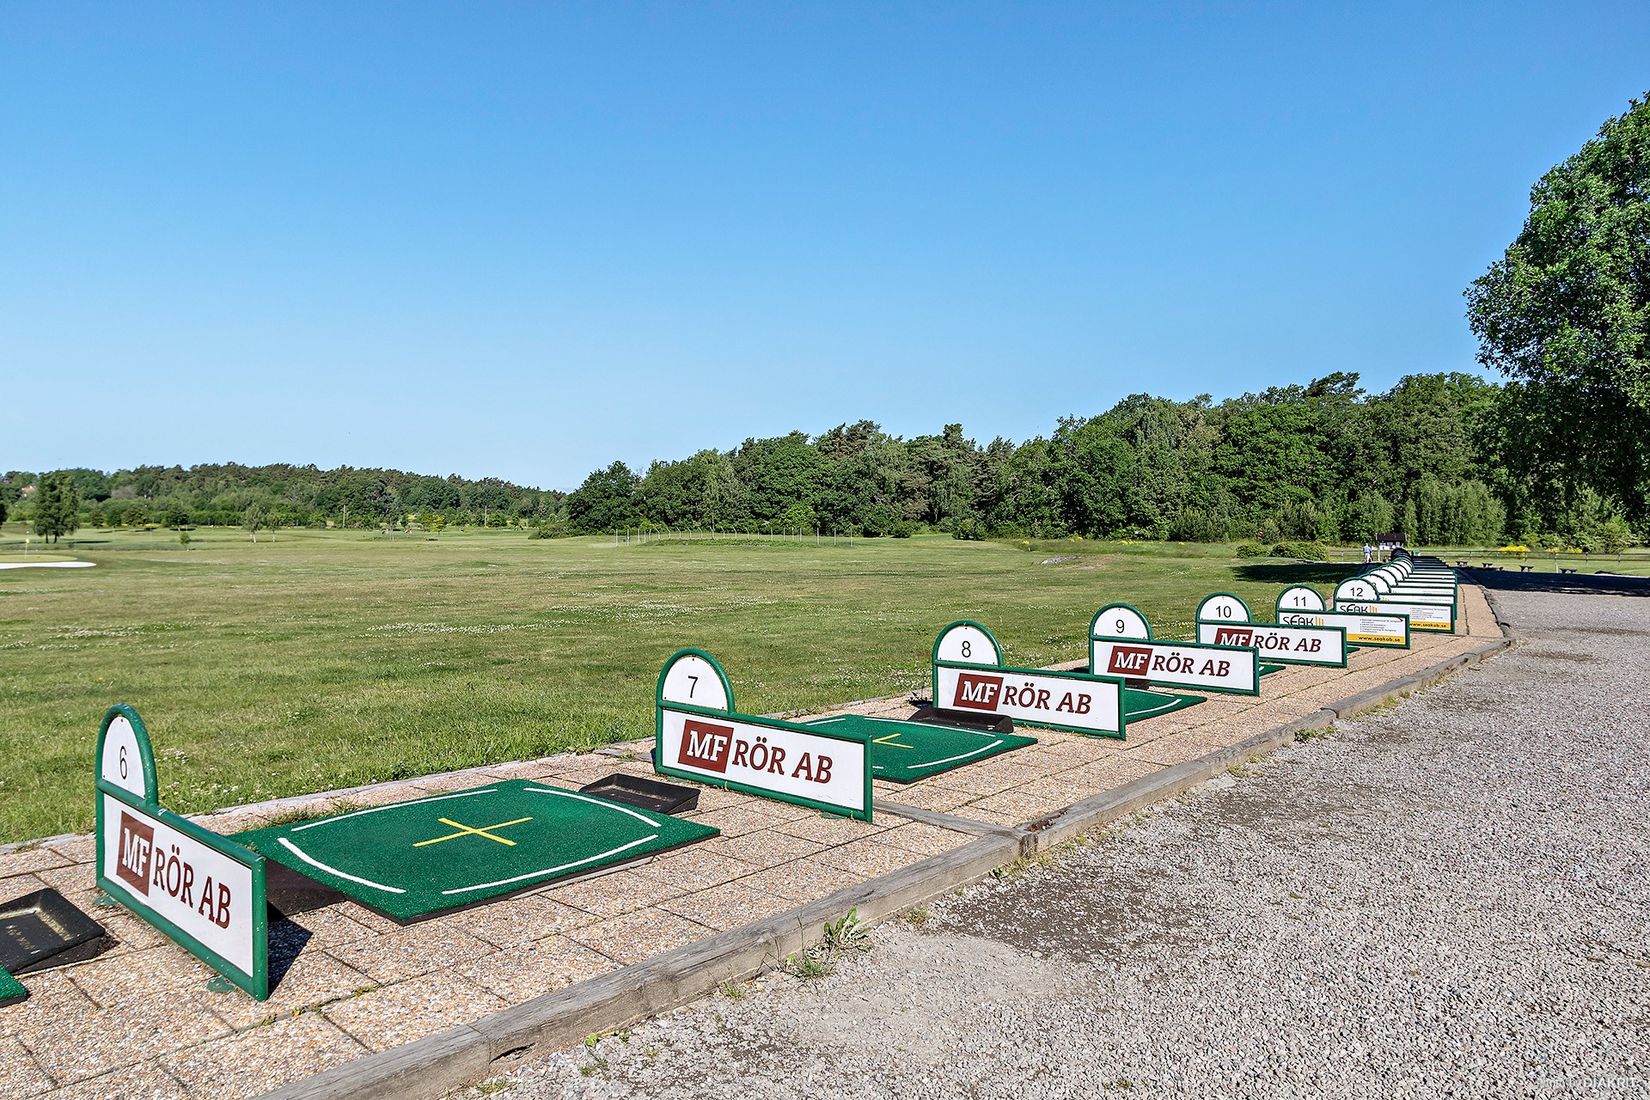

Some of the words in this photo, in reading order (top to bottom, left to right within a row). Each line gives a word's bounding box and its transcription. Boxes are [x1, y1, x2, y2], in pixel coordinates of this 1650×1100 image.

[1293, 596, 1307, 607] 11
[1350, 587, 1364, 597] 12
[1215, 605, 1232, 619] 10
[1115, 619, 1125, 634] 9
[961, 640, 972, 658] 8
[1219, 632, 1250, 647] MF
[1253, 632, 1291, 651] RÖR
[1294, 638, 1322, 653] AB
[1113, 650, 1149, 670] MF
[1151, 652, 1194, 674] RÖR
[1199, 658, 1231, 677] AB
[687, 675, 699, 699] 7
[960, 680, 999, 703] MF
[1002, 682, 1050, 710] RÖR
[1056, 692, 1092, 715] AB
[119, 745, 129, 780] 6
[686, 730, 728, 761] MF
[732, 736, 787, 775] RÖR
[791, 751, 833, 784] AB
[121, 828, 150, 876] MF
[153, 844, 194, 908] RÖR
[198, 876, 231, 929] AB
